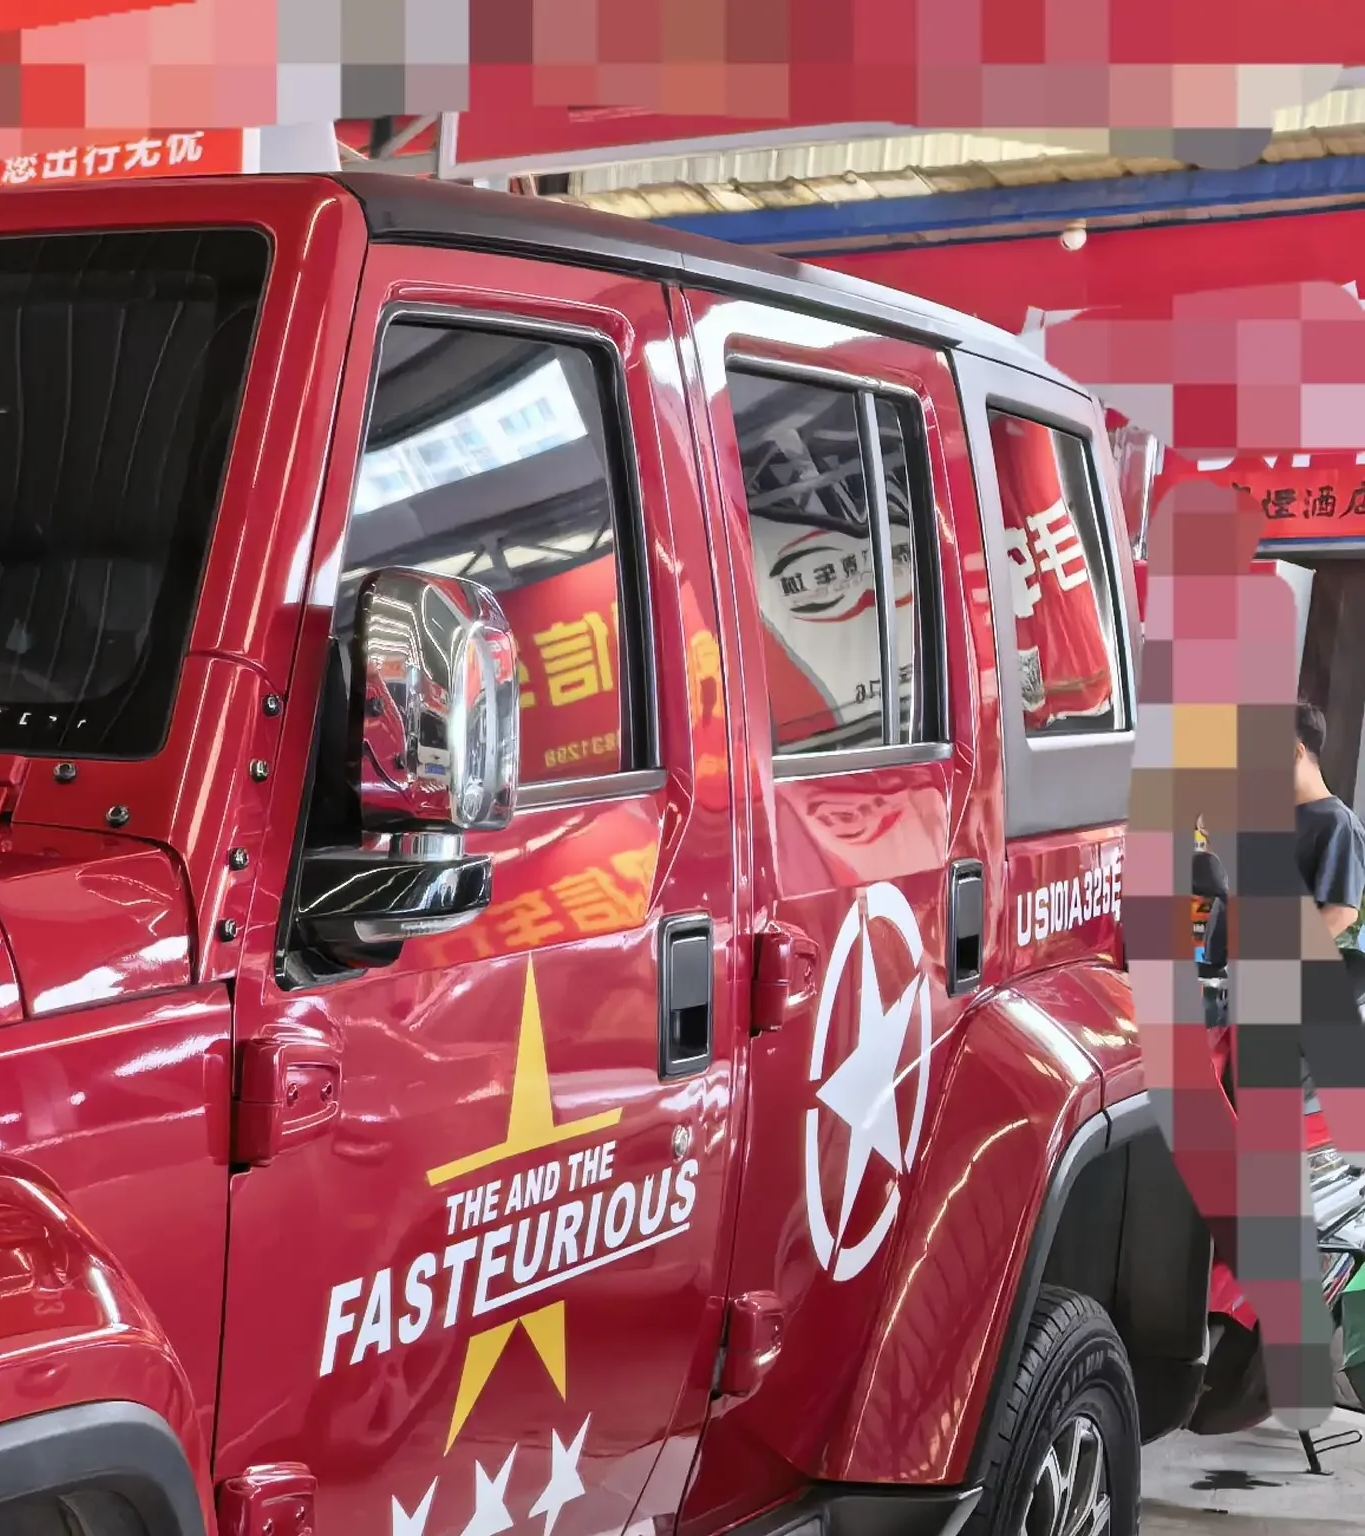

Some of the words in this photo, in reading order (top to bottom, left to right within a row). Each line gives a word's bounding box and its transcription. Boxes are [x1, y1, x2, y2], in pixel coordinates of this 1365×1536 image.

[446, 1180, 501, 1236] THE
[505, 1161, 561, 1215] AND
[567, 1140, 618, 1192] THE
